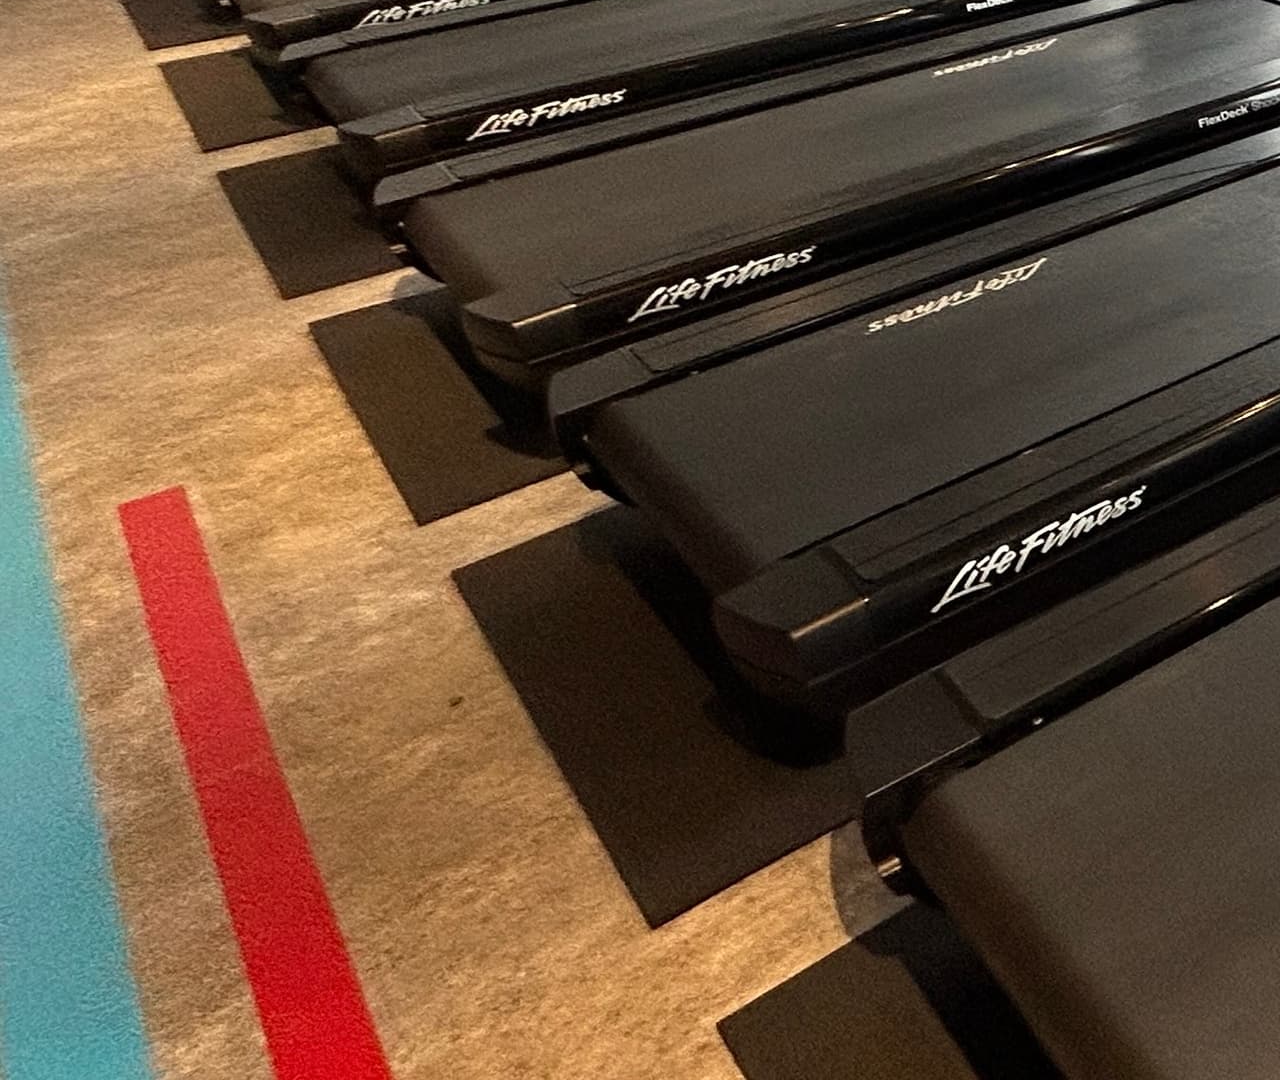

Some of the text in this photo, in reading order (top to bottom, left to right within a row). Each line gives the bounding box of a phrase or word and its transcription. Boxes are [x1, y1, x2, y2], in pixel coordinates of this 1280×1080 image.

[466, 89, 627, 142] Life Fitness
[1198, 104, 1248, 129] FlexDeck
[627, 246, 817, 323] Life Fitness
[930, 488, 1145, 614] Life Fitness
